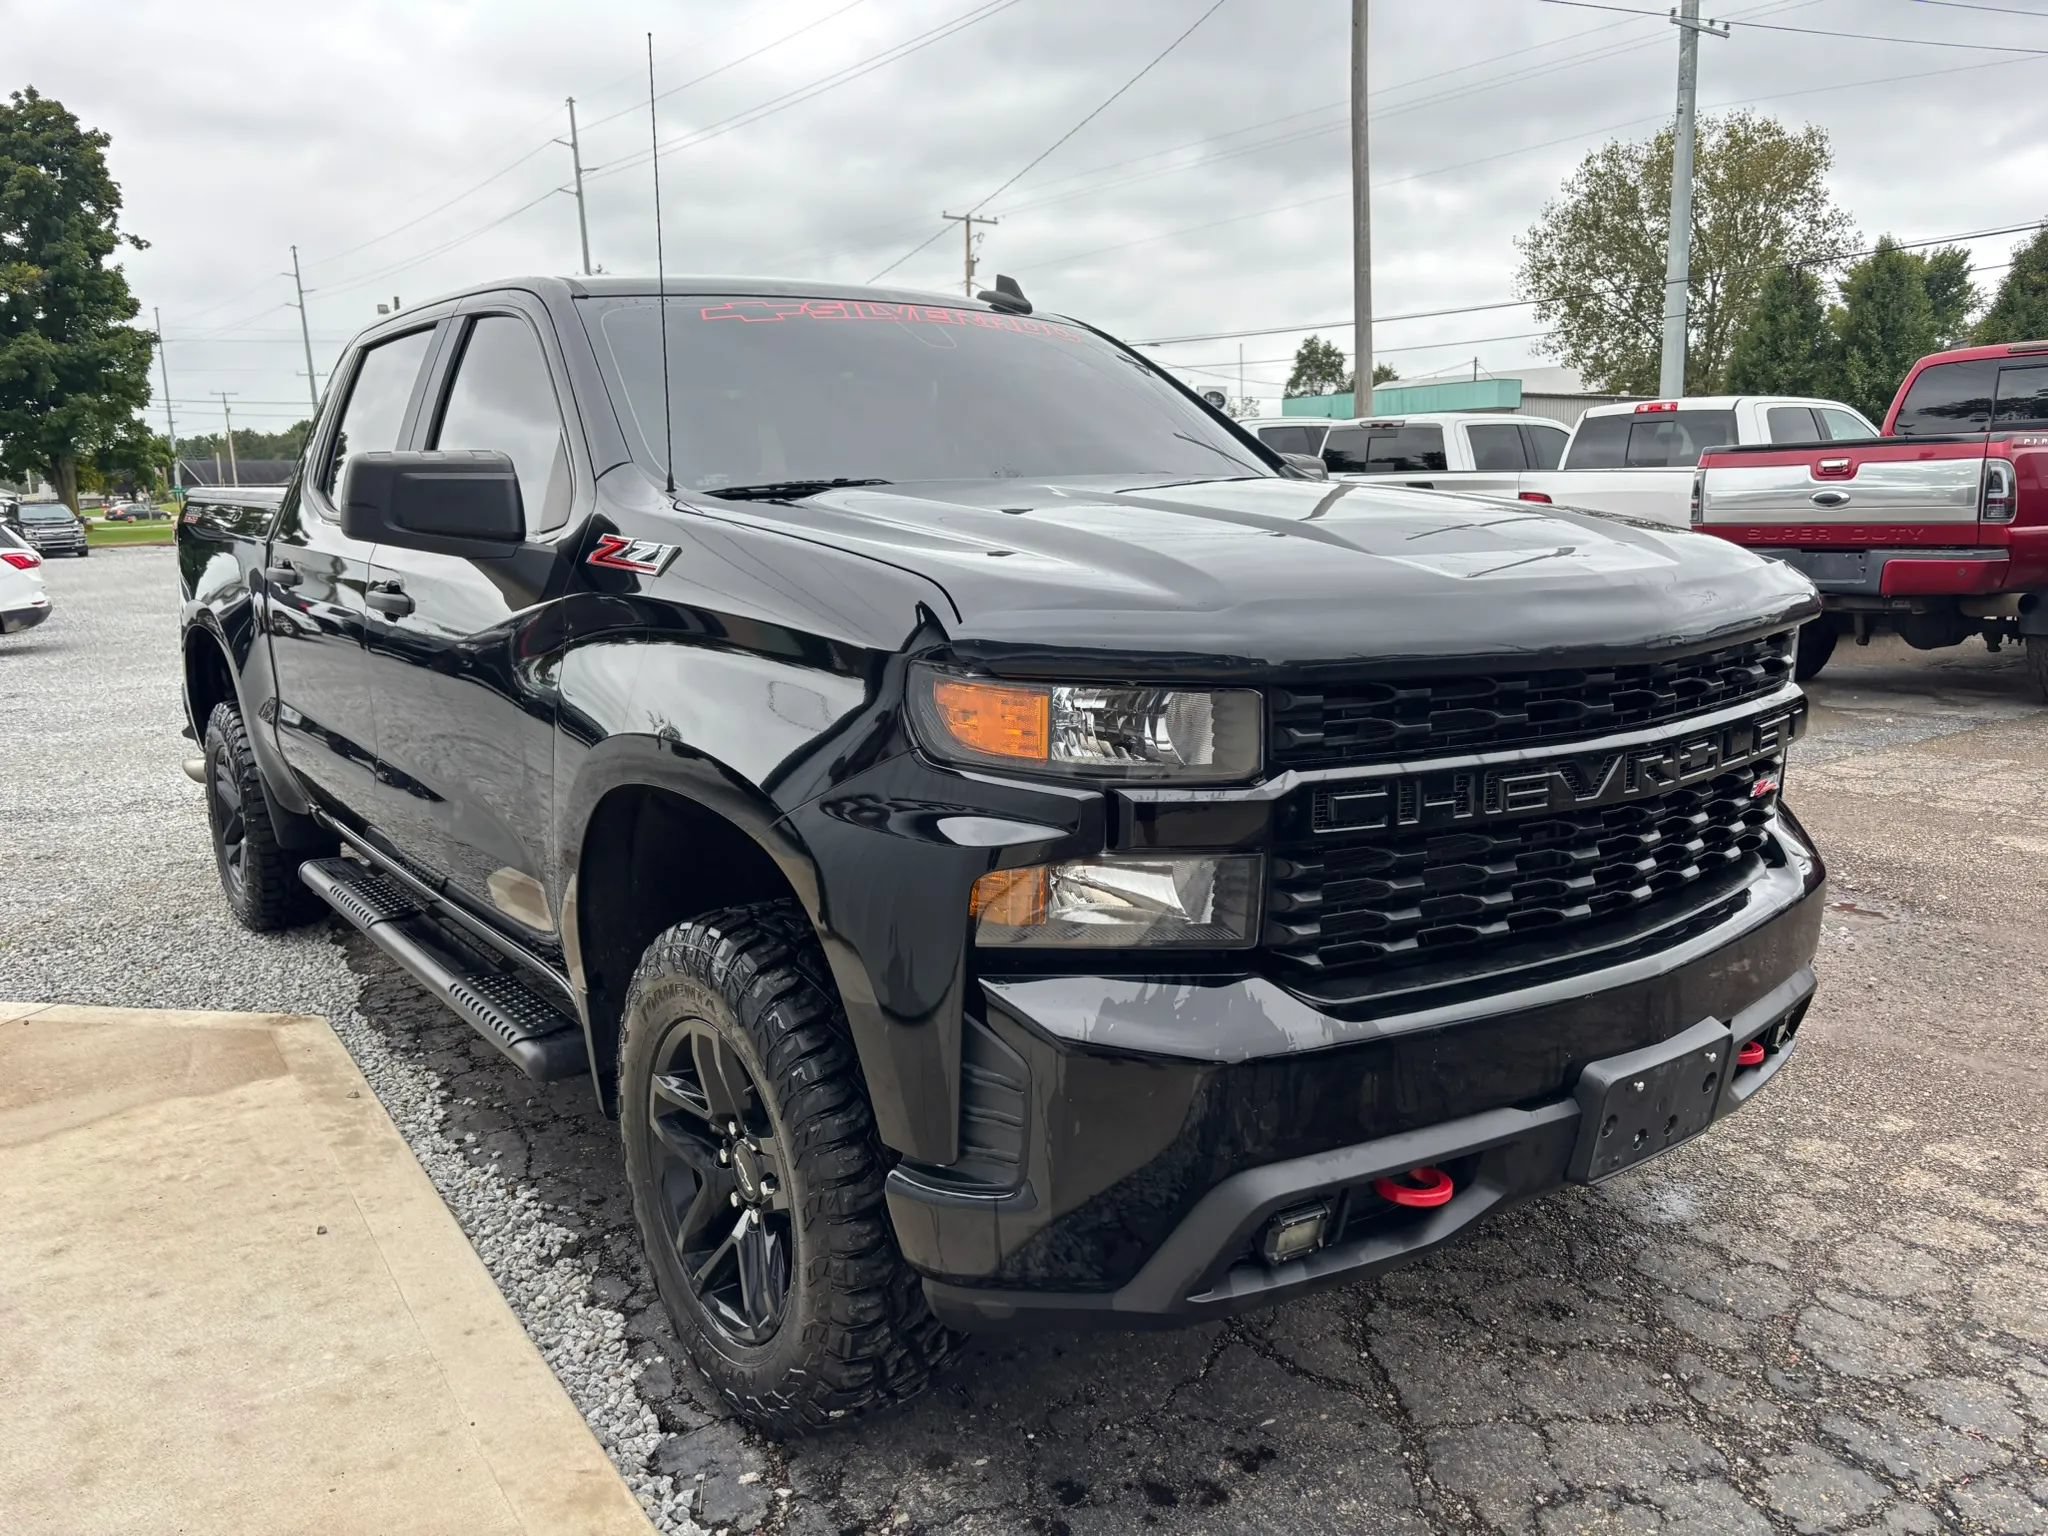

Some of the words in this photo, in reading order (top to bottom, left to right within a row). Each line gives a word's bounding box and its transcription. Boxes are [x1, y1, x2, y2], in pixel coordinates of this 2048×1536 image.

[1748, 528, 1831, 541] SUPER
[1850, 528, 1924, 541] DUTY
[585, 533, 683, 577] Z71
